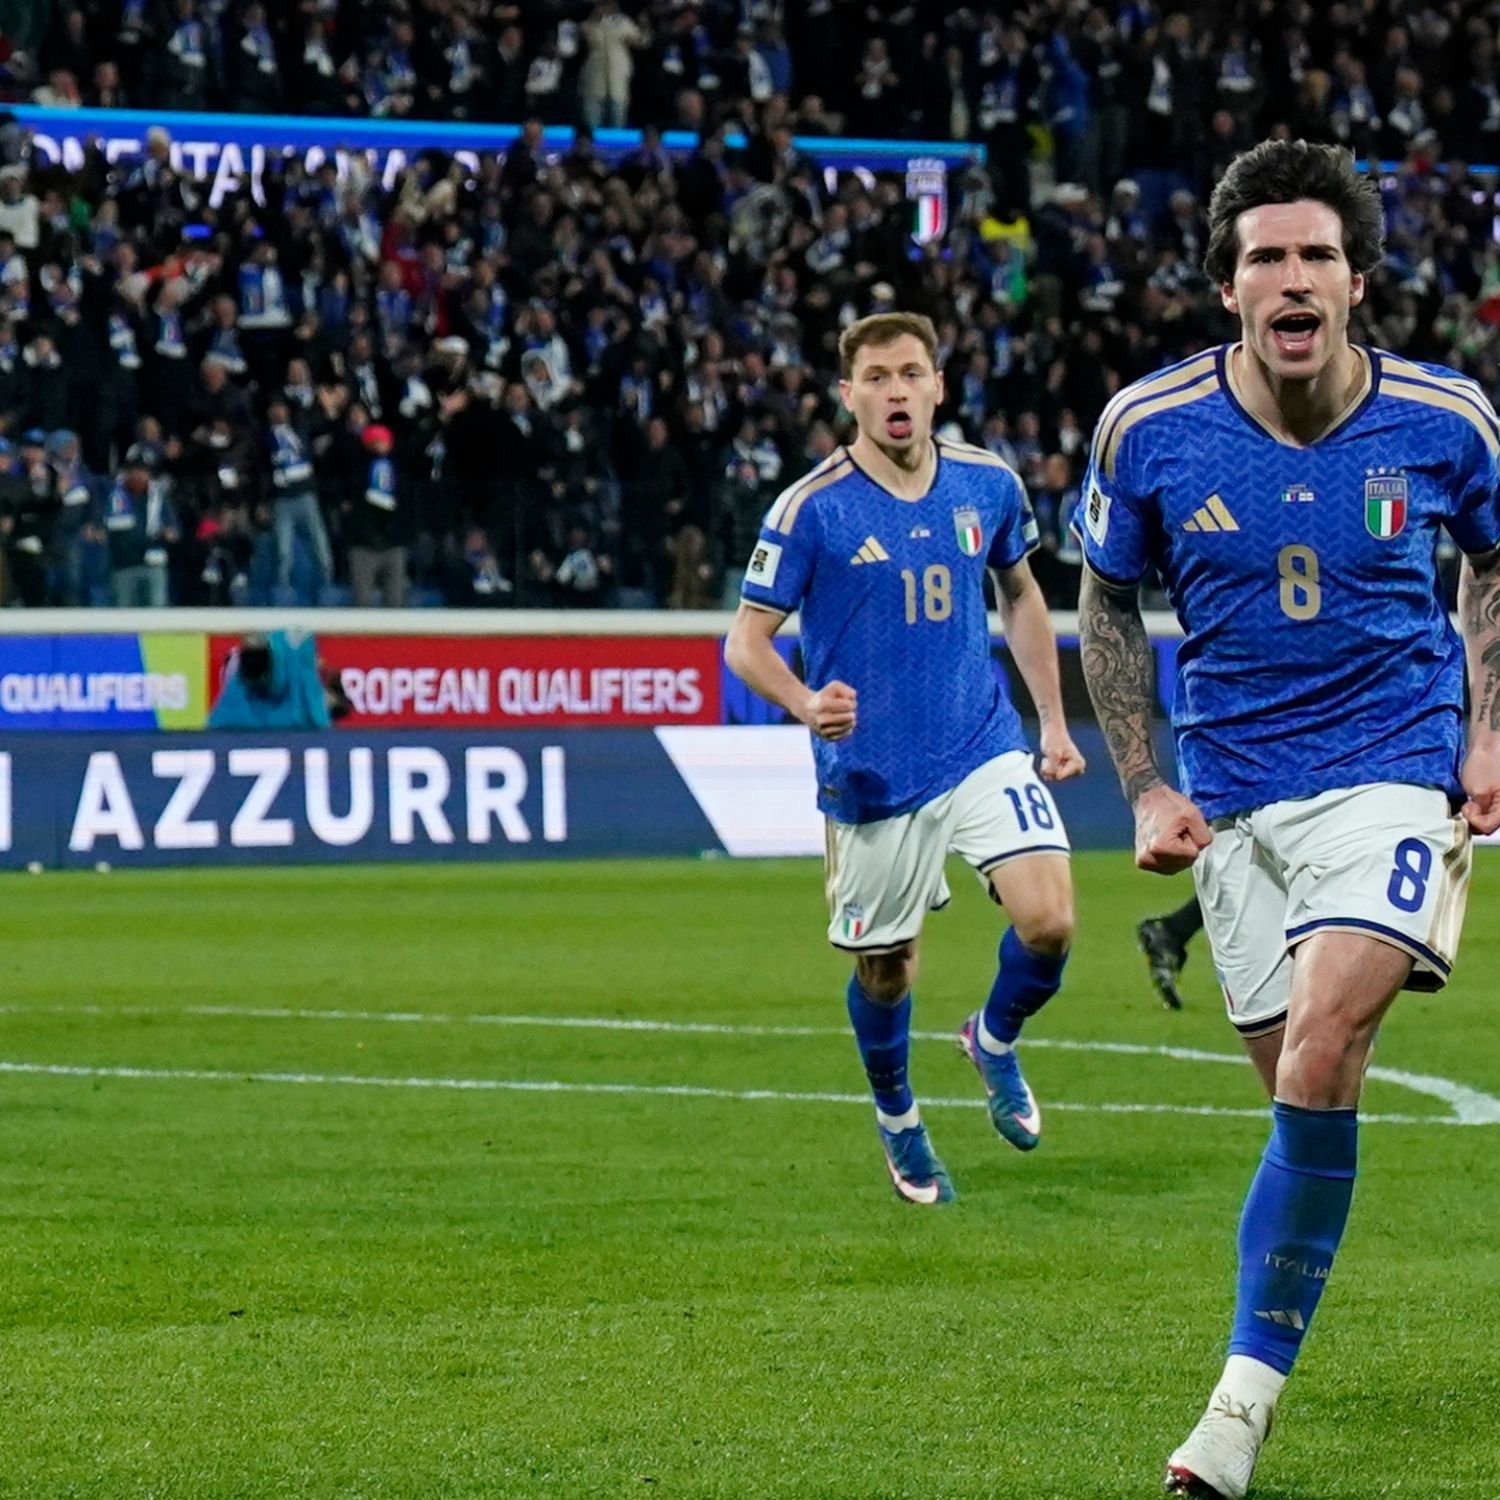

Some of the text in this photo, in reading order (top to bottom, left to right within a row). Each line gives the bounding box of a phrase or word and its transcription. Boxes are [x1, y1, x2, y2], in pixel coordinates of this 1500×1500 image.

[1368, 482, 1404, 495] ITALIA
[901, 564, 952, 625] 18
[1278, 544, 1321, 620] 8
[0, 672, 188, 713] QUALIFIERS
[340, 667, 703, 715] ROPEAN QUALIFIERS
[69, 746, 568, 852] AZZURRI
[1003, 783, 1054, 831] 18
[1387, 837, 1432, 913] 8
